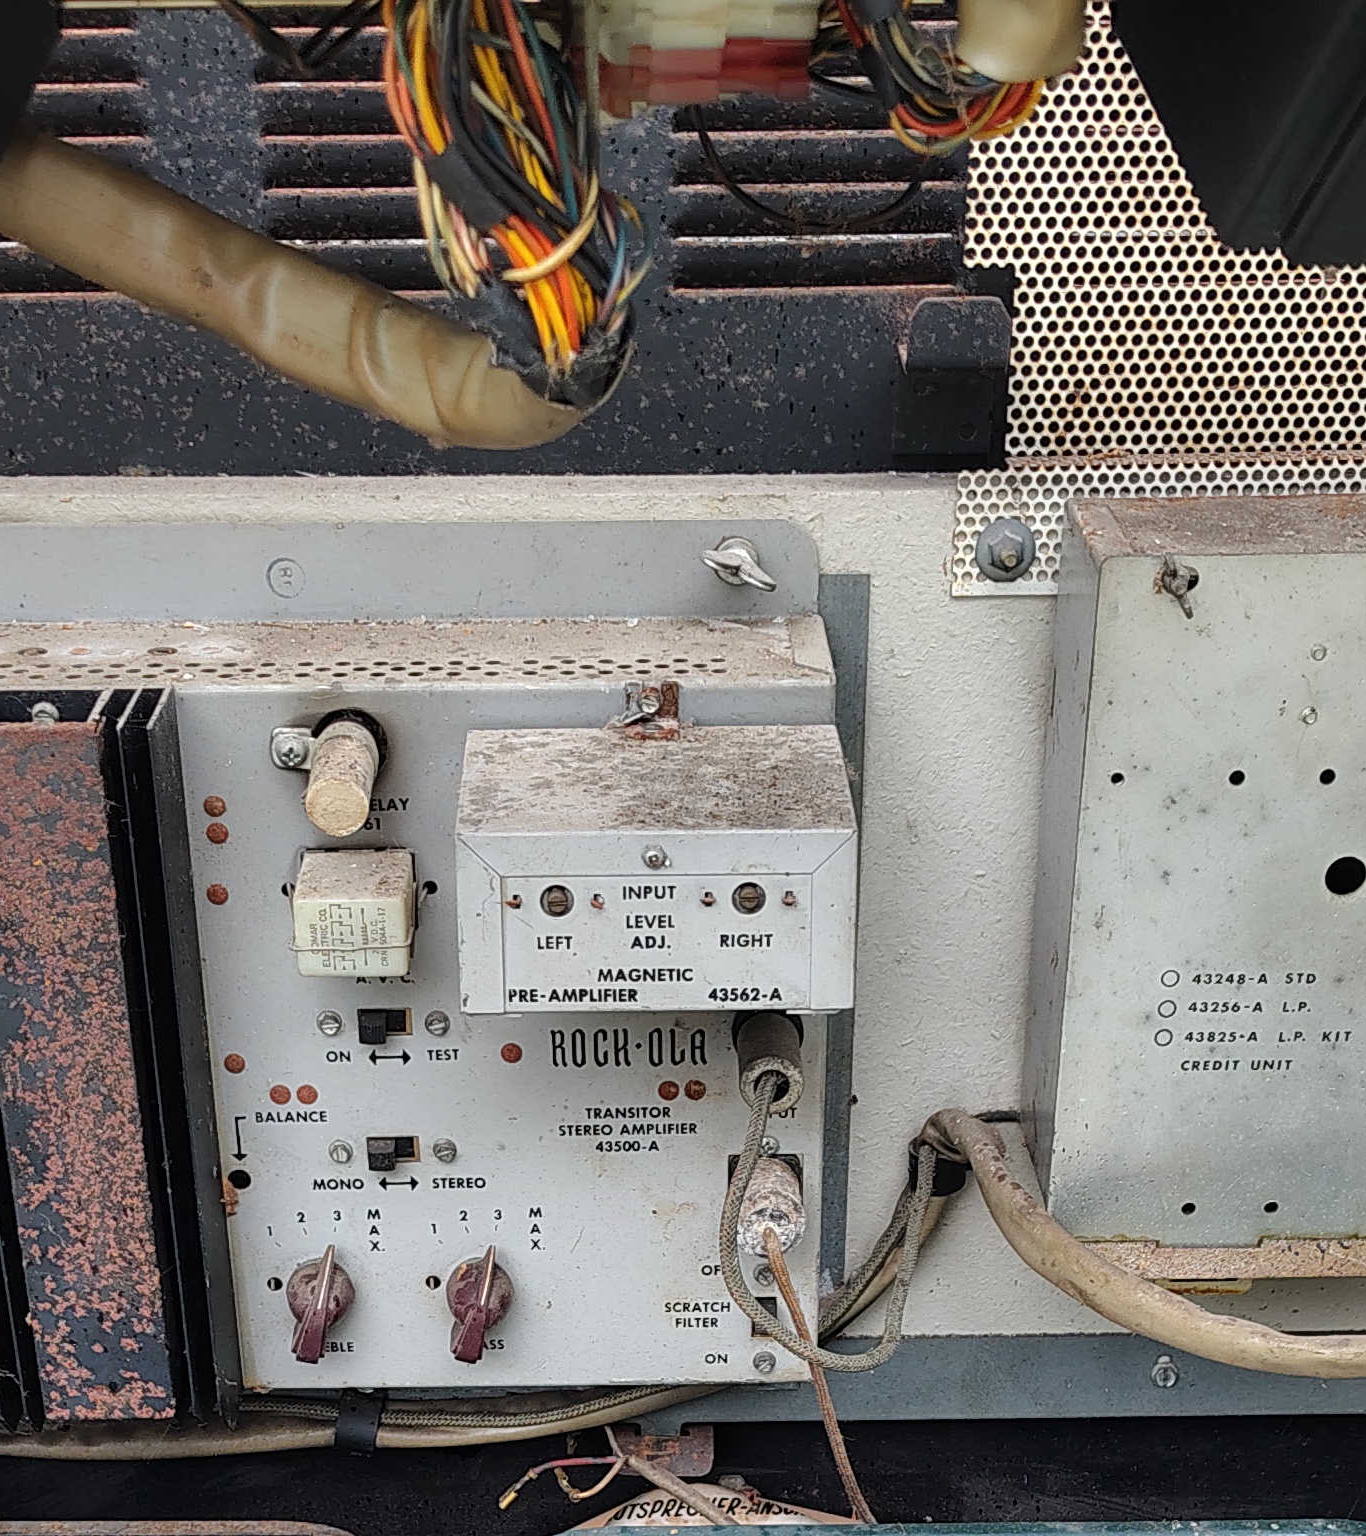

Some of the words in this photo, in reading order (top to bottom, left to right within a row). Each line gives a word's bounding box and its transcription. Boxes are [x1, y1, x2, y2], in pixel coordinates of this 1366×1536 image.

[370, 797, 410, 811] ELAY
[622, 885, 677, 900] INPUT
[625, 915, 676, 929] LEVEL
[536, 936, 573, 950] LEFT
[630, 935, 672, 950] ADJ.
[719, 933, 774, 948] RIGHT
[597, 968, 694, 983] MAGNETIC
[1191, 973, 1269, 985] 43248-A
[1285, 972, 1317, 985] STD
[508, 988, 639, 1002] PRE-AMPLIFIER
[707, 987, 783, 1002] 43562-A
[1187, 1001, 1264, 1013] 43256-A
[1282, 1001, 1312, 1013] L.P.
[1184, 1031, 1258, 1043] 43825-A
[1278, 1031, 1307, 1043] L.P.
[1321, 1030, 1353, 1042] KIT
[325, 1050, 352, 1063] ON
[426, 1049, 460, 1061] TEST
[1180, 1060, 1241, 1071] CREDIT
[1250, 1059, 1294, 1071] UNIT
[254, 1110, 328, 1123] BALANCE
[584, 1106, 671, 1120] TRANSITOR
[558, 1124, 613, 1137] STEREO
[619, 1122, 699, 1136] AMPLIFIER
[594, 1140, 660, 1152] 43500-A
[312, 1178, 365, 1191] MONO
[431, 1176, 487, 1189] STEREO
[266, 1225, 273, 1237] 1
[296, 1211, 306, 1223] 2
[333, 1210, 342, 1222] 3
[430, 1223, 437, 1235] 1
[459, 1210, 468, 1222] 2
[493, 1209, 503, 1221] 3
[701, 1264, 722, 1276] OF
[664, 1301, 731, 1313] SCRATCH
[675, 1317, 719, 1329] FILTER
[704, 1353, 728, 1364] ON
